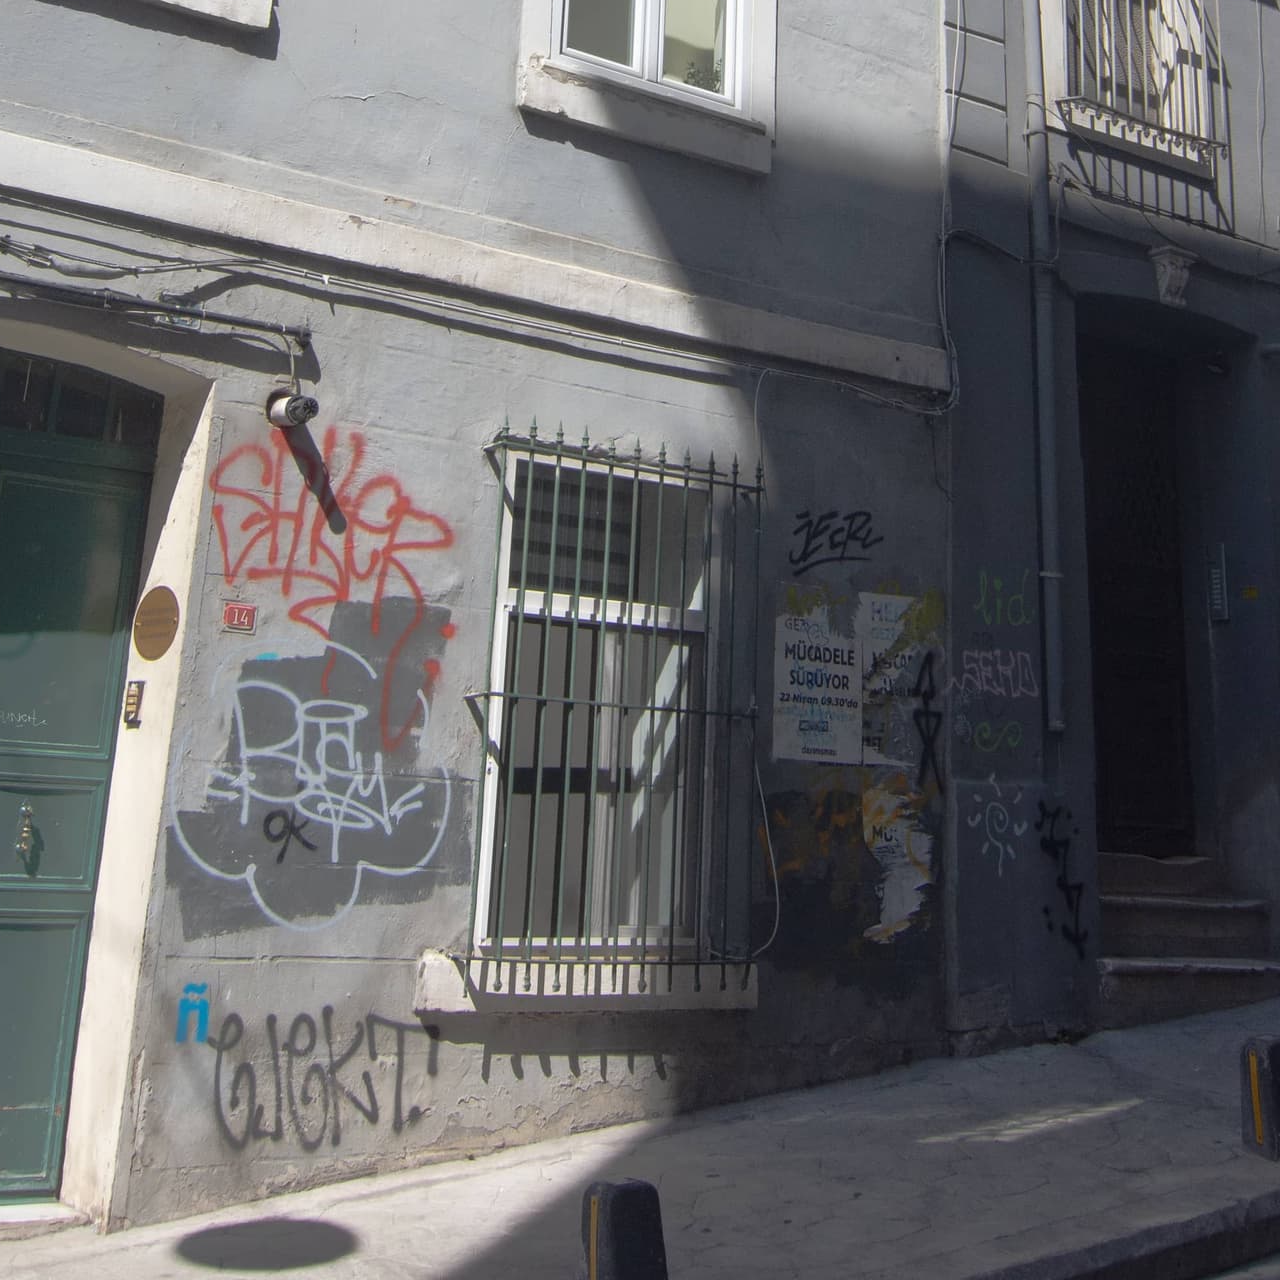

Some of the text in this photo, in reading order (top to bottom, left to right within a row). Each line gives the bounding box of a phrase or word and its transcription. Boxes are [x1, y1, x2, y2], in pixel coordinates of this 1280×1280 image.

[231, 608, 249, 626] 14
[784, 640, 855, 666] MÜCADELE
[789, 665, 850, 690] SÜRÜYOR
